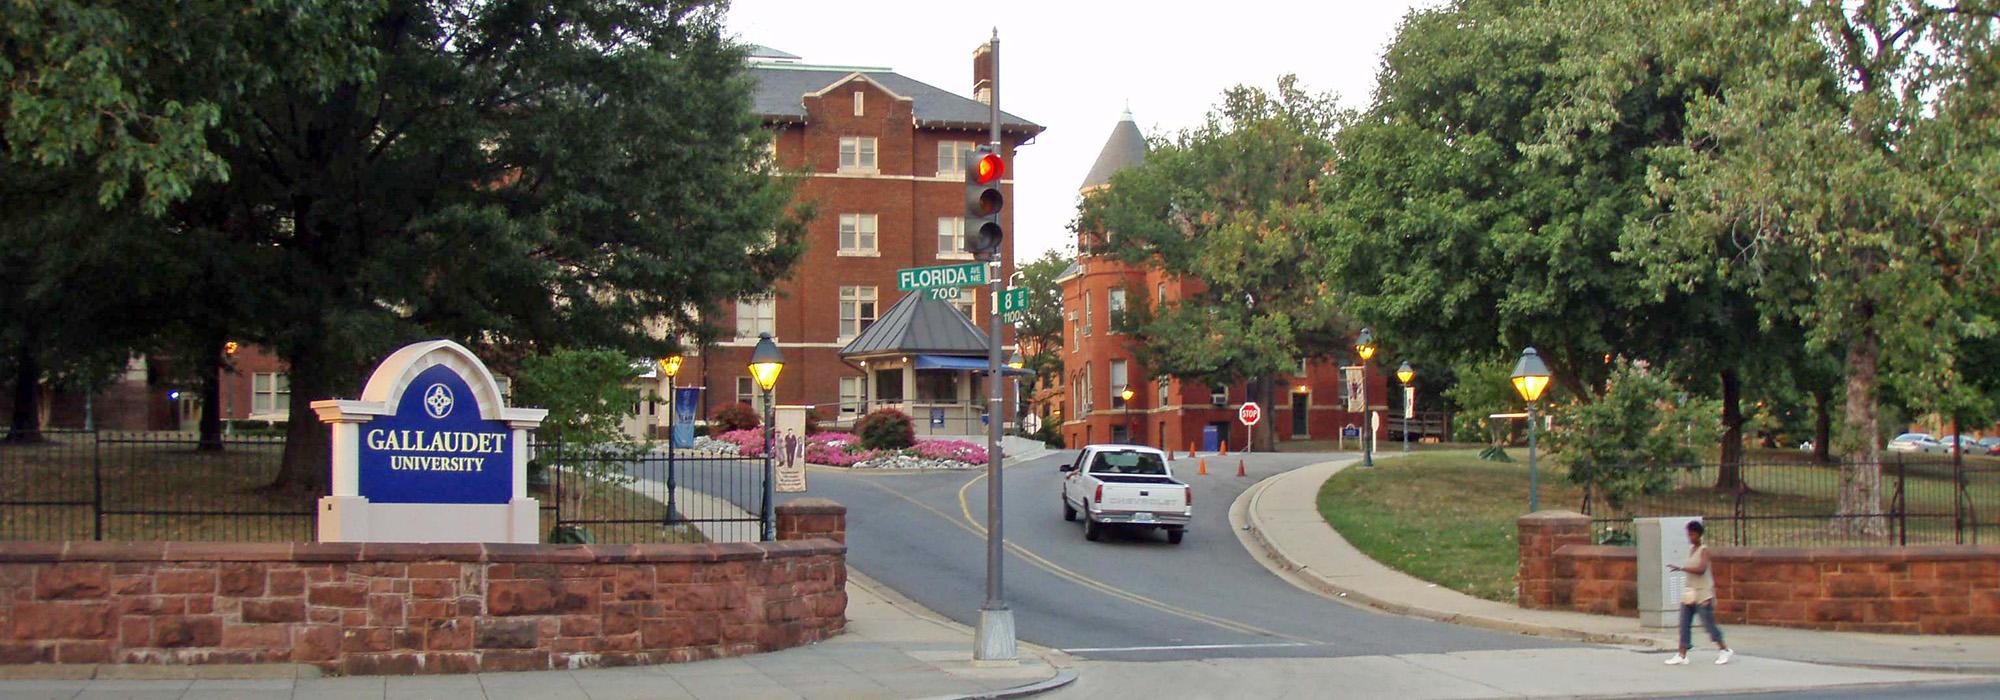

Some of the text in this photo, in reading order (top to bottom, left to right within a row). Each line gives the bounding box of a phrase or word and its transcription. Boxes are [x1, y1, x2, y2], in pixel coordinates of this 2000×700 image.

[901, 266, 981, 288] FLORIDA AVE
[931, 287, 958, 299] 700
[1005, 293, 1012, 310] 8
[1004, 311, 1020, 324] 1100
[1242, 409, 1257, 418] STOP
[367, 429, 507, 453] GALLAUDET
[391, 456, 484, 471] UNIVERSITY
